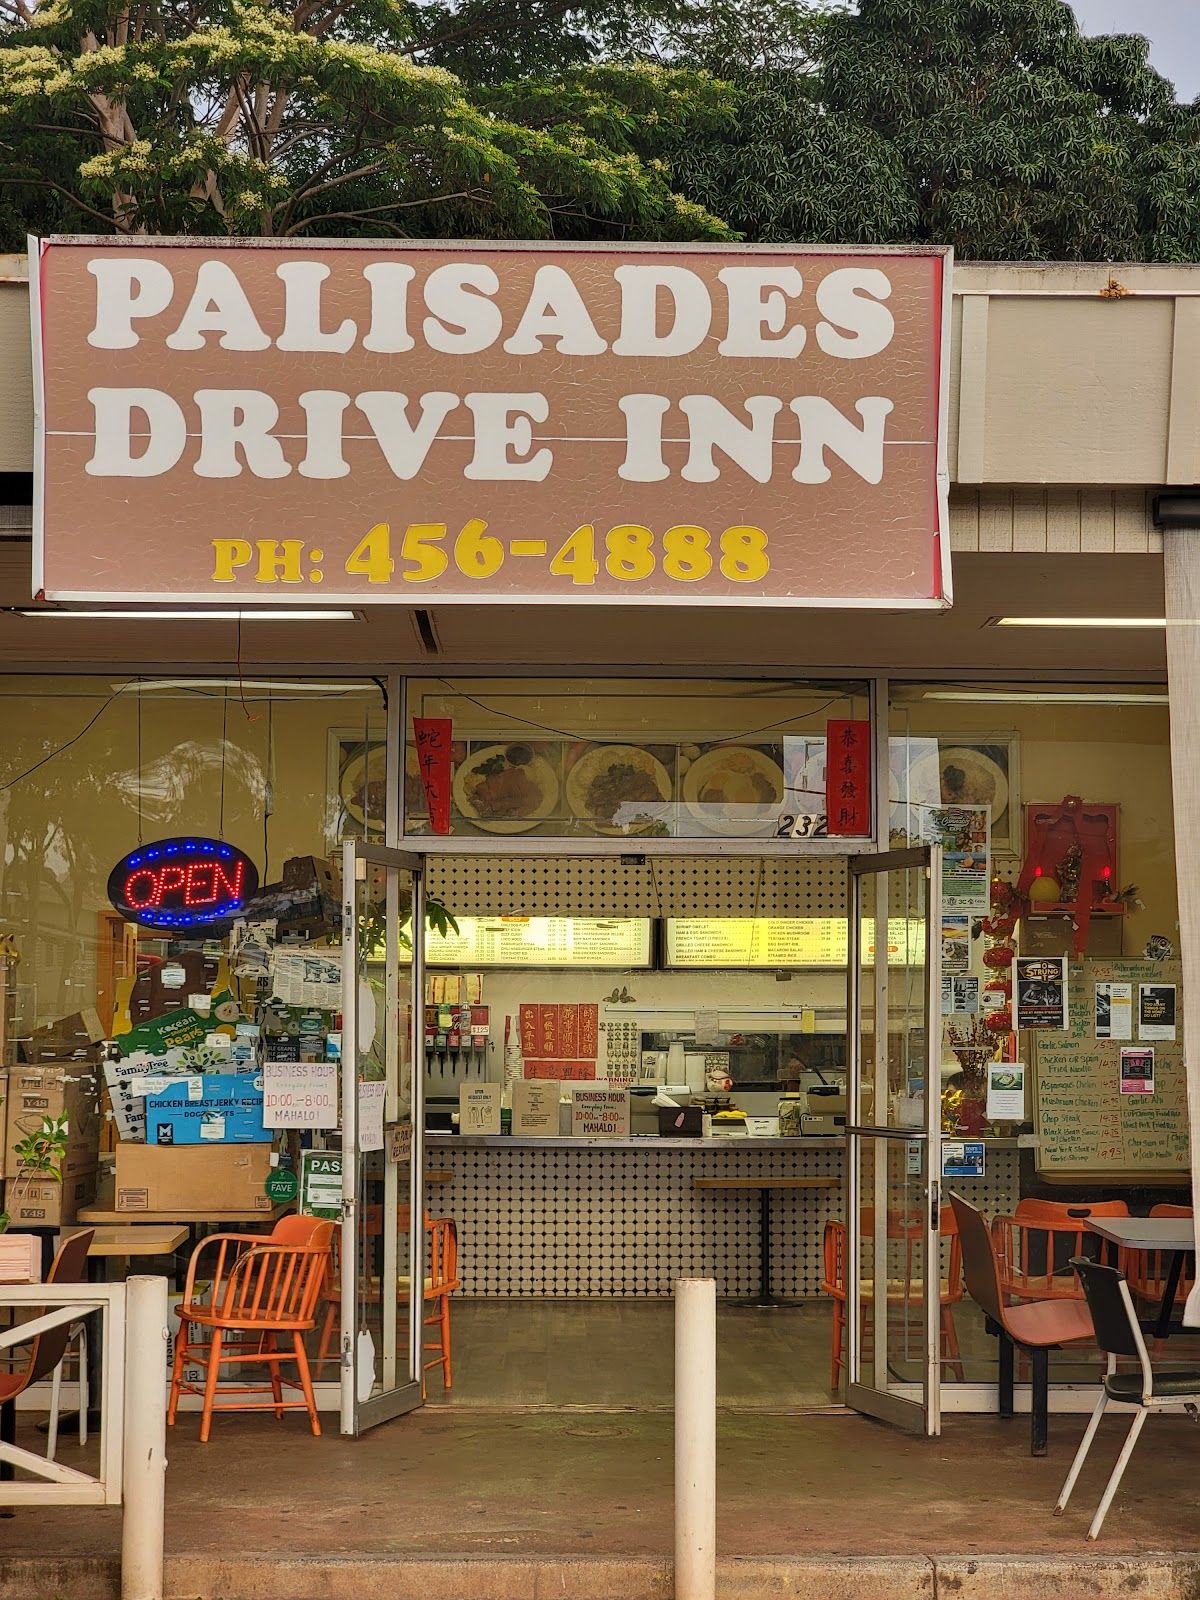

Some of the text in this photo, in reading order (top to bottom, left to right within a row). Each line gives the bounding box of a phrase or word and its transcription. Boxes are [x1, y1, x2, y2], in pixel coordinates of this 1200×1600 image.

[87, 258, 896, 359] PALISADES
[85, 387, 895, 485] DRIVE INN
[210, 518, 771, 585] PH: 456-4888
[777, 815, 828, 836] 232
[125, 861, 243, 909] OPEN
[157, 1014, 197, 1035] Korean
[164, 1027, 205, 1049] Pears
[266, 1065, 335, 1078] BUSINESS HOUR
[25, 1099, 48, 1108] Y48
[149, 1097, 264, 1108] CHICKEN BREAST JERKY RECIP
[576, 1092, 626, 1102] BUSINESS HOUR
[583, 1123, 616, 1133] MAHALO!
[311, 1159, 343, 1173] PAS
[271, 1183, 293, 1193] FAVE
[22, 1209, 45, 1218] Y48
